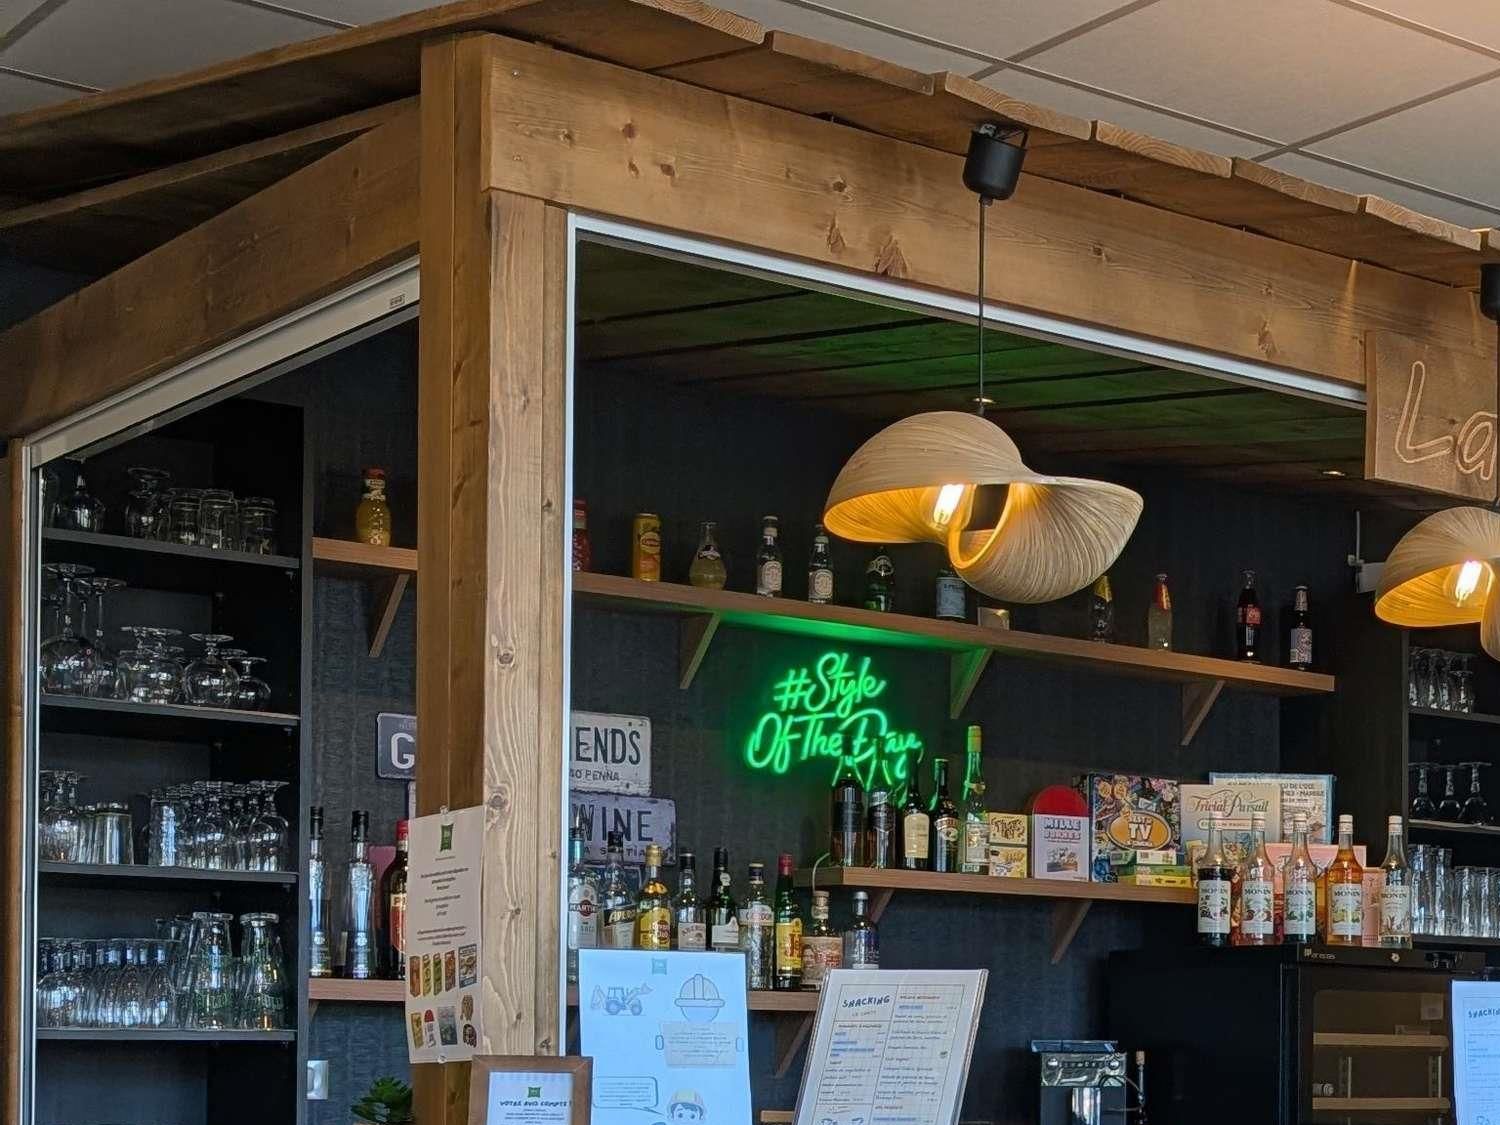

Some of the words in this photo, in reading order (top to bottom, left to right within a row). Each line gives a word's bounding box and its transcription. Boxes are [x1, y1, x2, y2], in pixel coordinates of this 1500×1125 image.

[1395, 361, 1499, 481] La
[773, 651, 888, 719] #Style
[569, 726, 641, 765] ENDS
[1187, 790, 1226, 814] Trivial
[1225, 789, 1269, 817] Pursuit
[571, 803, 654, 842] WINE
[1128, 822, 1152, 841] TV
[1201, 887, 1228, 895] MONIN
[1244, 888, 1271, 896] MONIN
[1286, 888, 1312, 896] MONIN
[1334, 889, 1360, 897] MONIN
[1380, 891, 1407, 899] MONIN
[842, 995, 890, 1008] SNACKING
